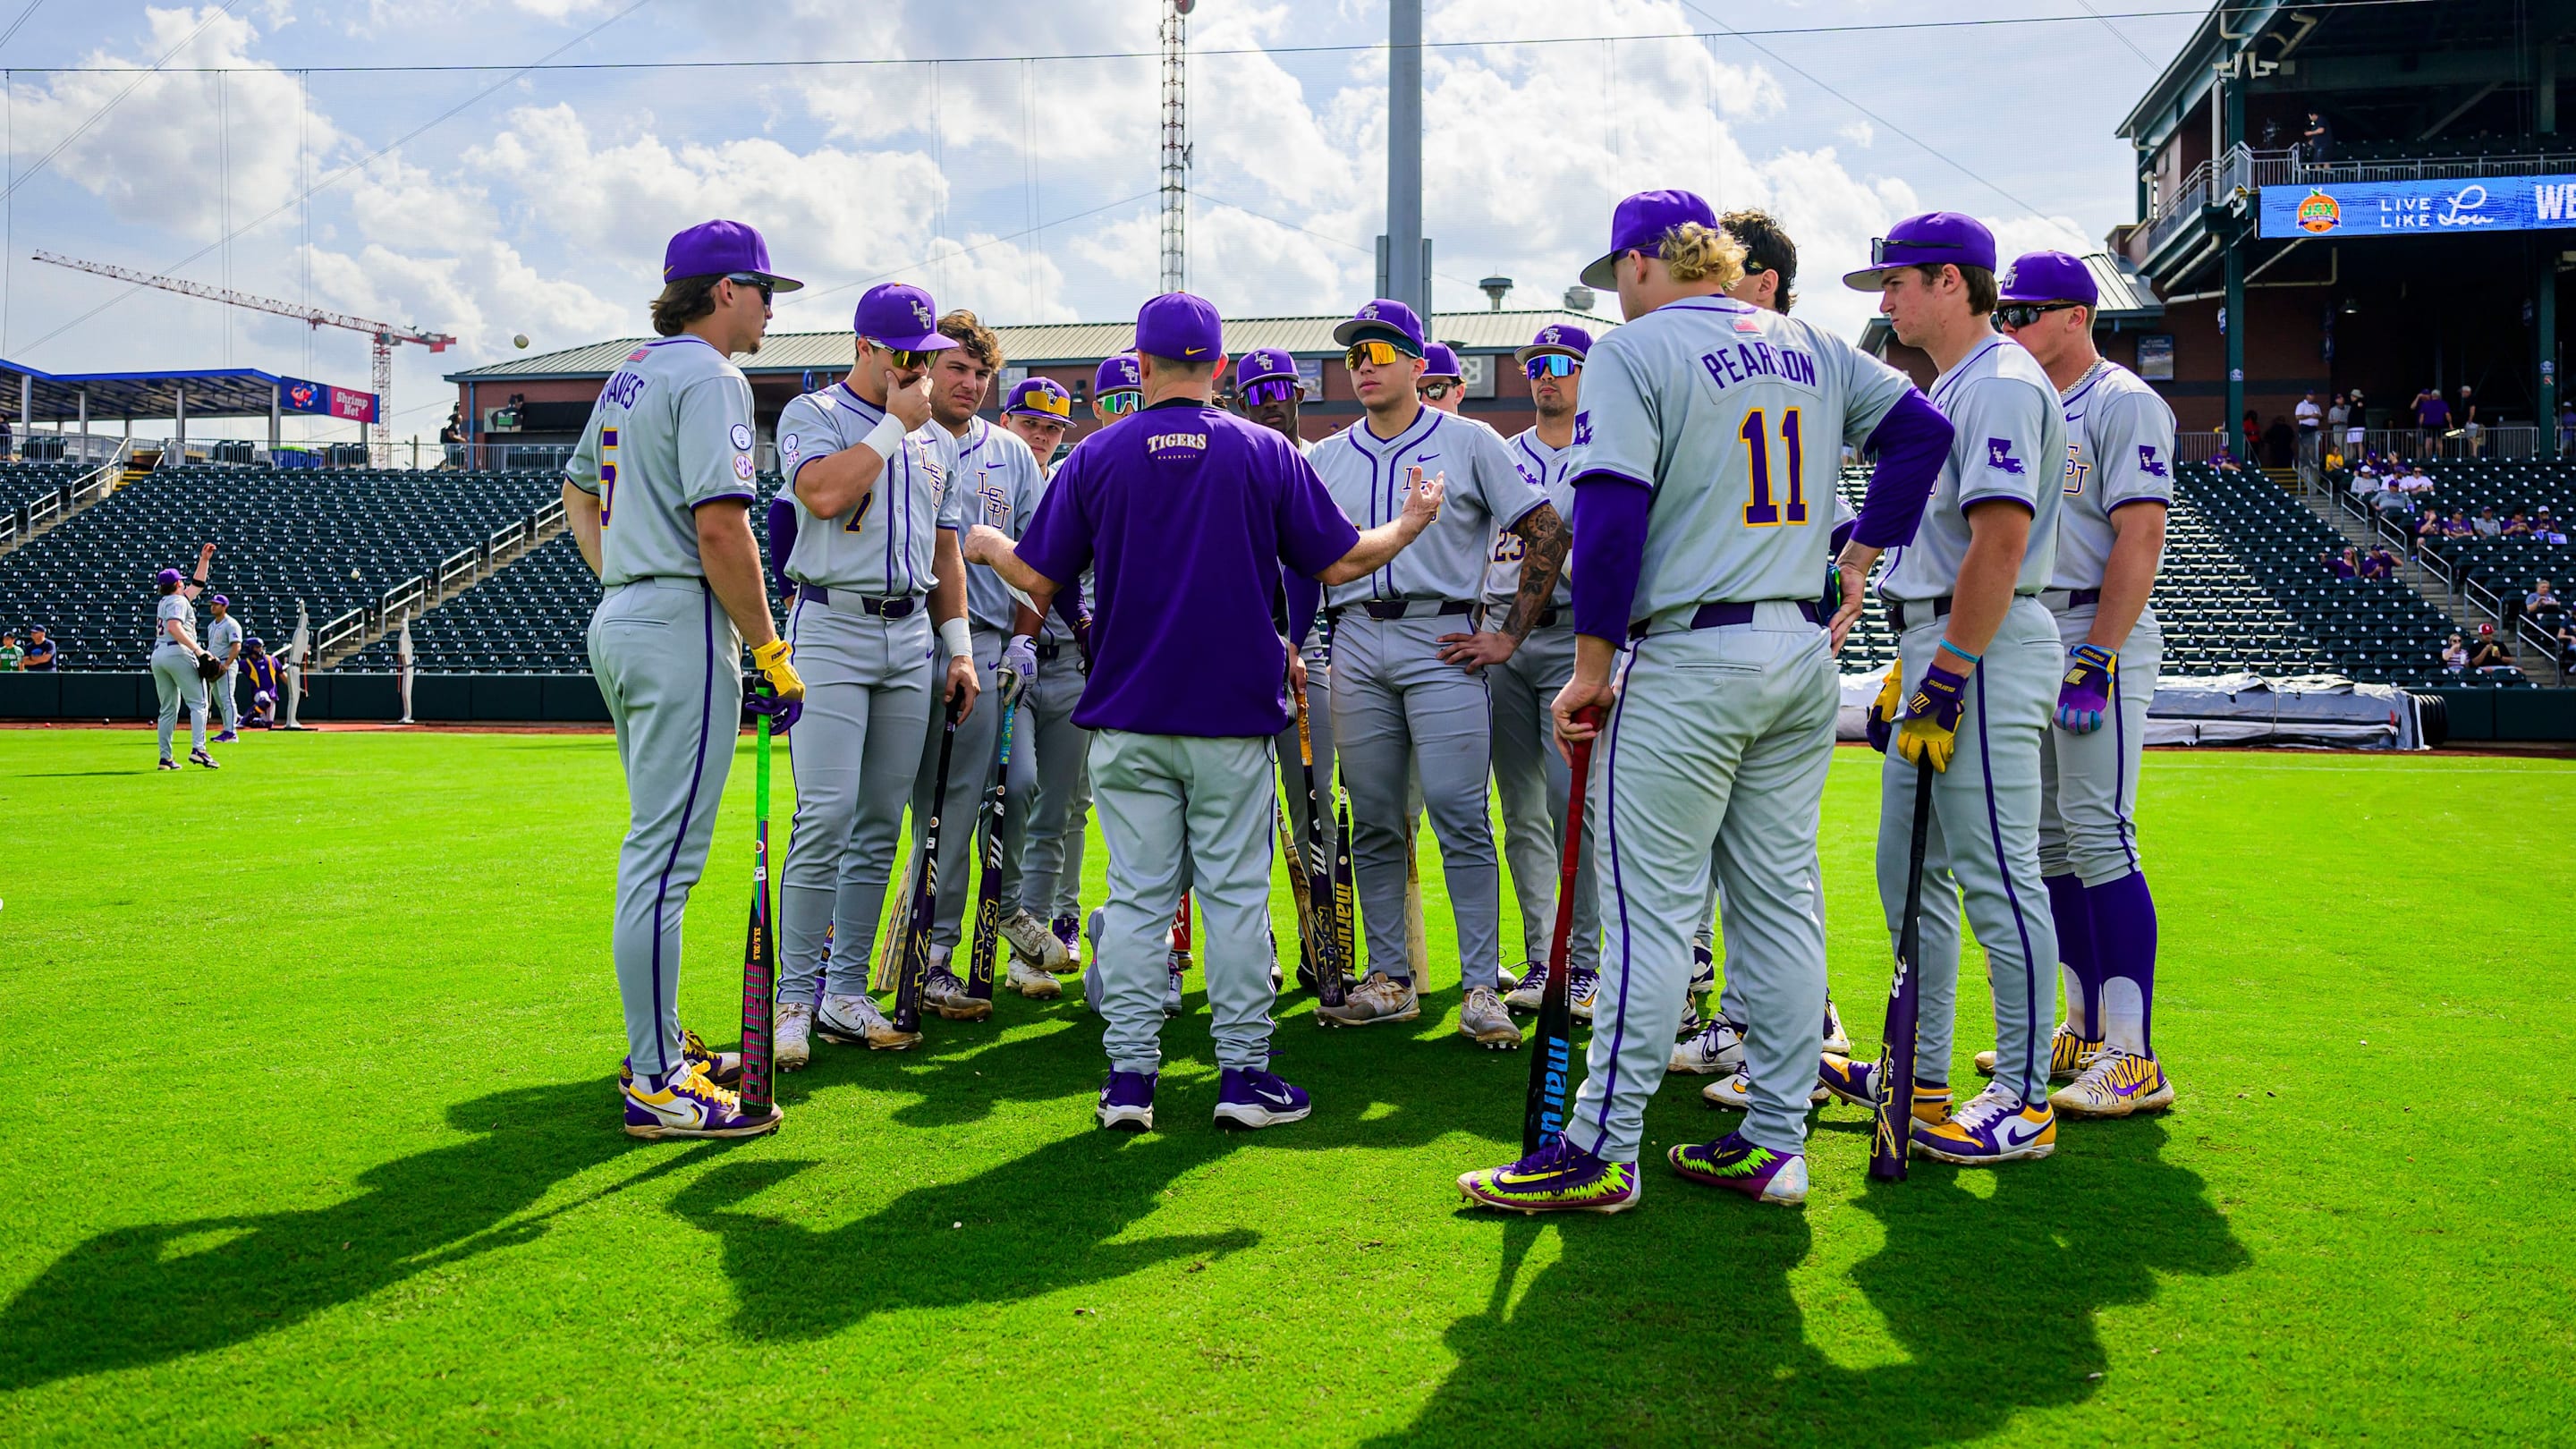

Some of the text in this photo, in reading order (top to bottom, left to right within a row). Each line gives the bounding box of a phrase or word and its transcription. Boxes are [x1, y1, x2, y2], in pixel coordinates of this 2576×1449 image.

[2303, 204, 2334, 216] JAX
[2381, 198, 2430, 212] LIVE
[2381, 214, 2430, 228] LIKE
[911, 301, 931, 329] LSU
[1543, 326, 1562, 344] LSU
[1120, 360, 1139, 384] LSU
[1254, 352, 1273, 370] LSU
[1700, 342, 1817, 390] PEARSON
[336, 392, 369, 410] Shrimp
[343, 404, 359, 417] Net
[1147, 433, 1207, 453] TIGERS
[735, 455, 753, 478] SEC
[1739, 406, 1809, 528] 11
[599, 427, 618, 530] 5
[918, 446, 945, 511] LSU
[975, 470, 1011, 530] LSU
[1492, 527, 1528, 564] 23
[1928, 679, 1955, 693] marucci
[1335, 882, 1355, 979] marucci
[741, 963, 772, 1108] marucci
